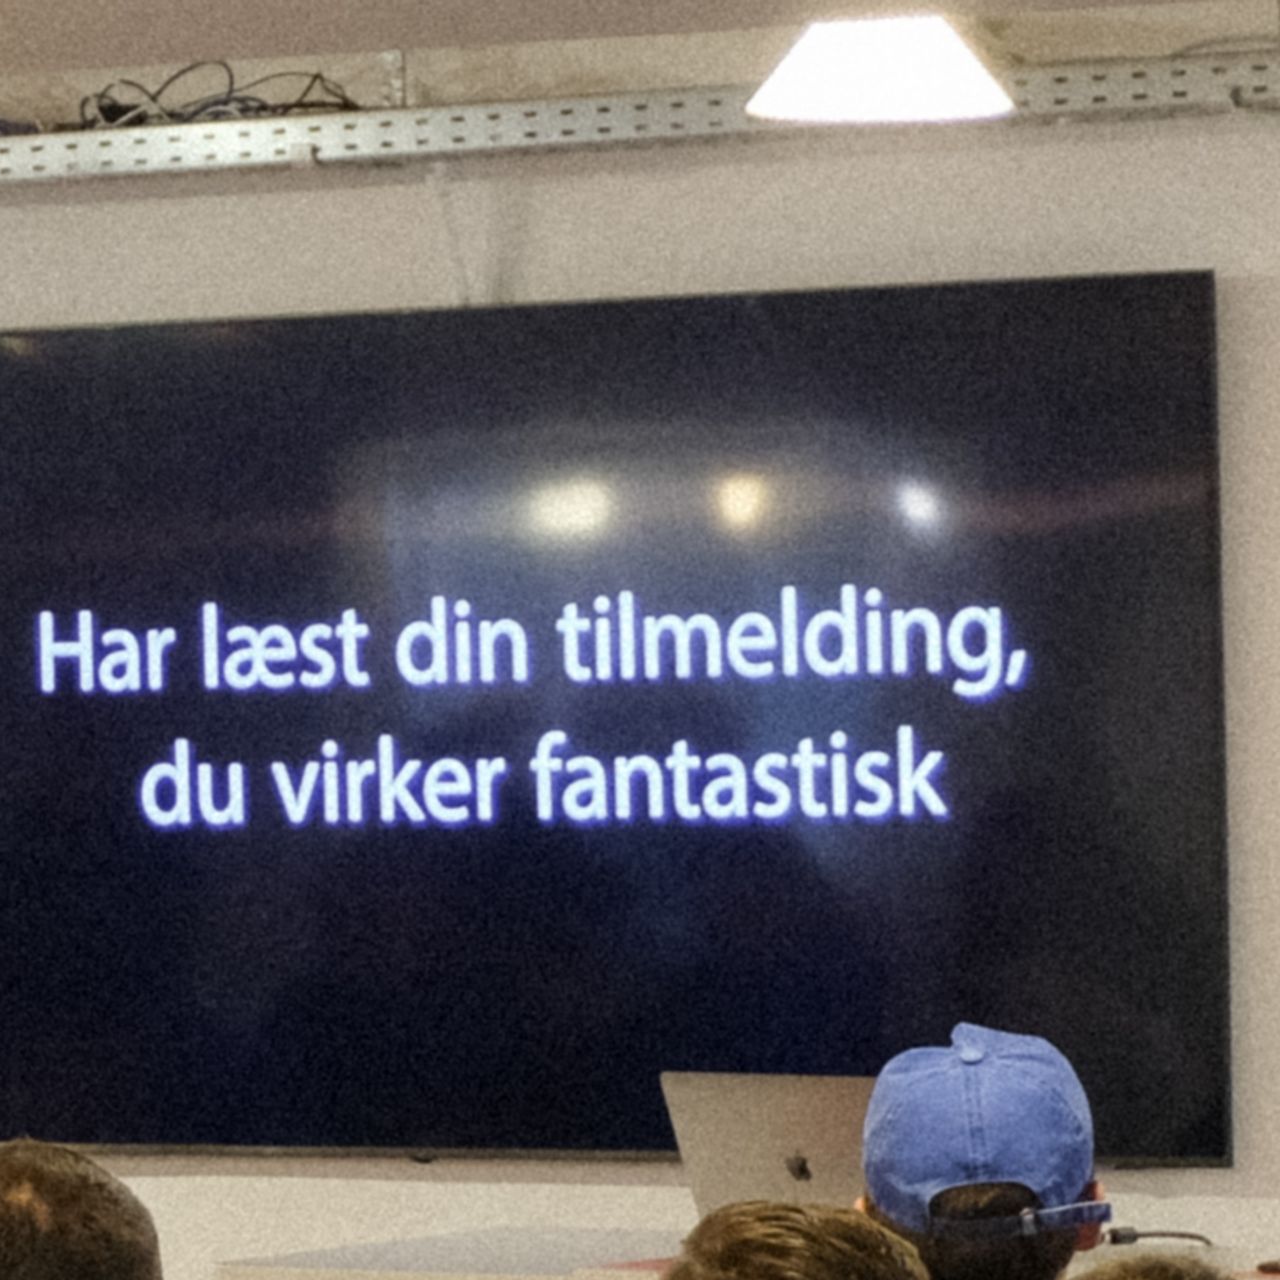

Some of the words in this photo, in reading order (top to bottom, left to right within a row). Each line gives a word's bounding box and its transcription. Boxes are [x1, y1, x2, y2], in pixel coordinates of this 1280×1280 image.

[38, 609, 176, 692] Har
[202, 601, 370, 689] læst
[394, 594, 529, 686] din
[554, 584, 1028, 698] tilmelding,
[140, 737, 244, 826] du
[270, 733, 506, 823] virker
[528, 724, 947, 821] fantastisk
